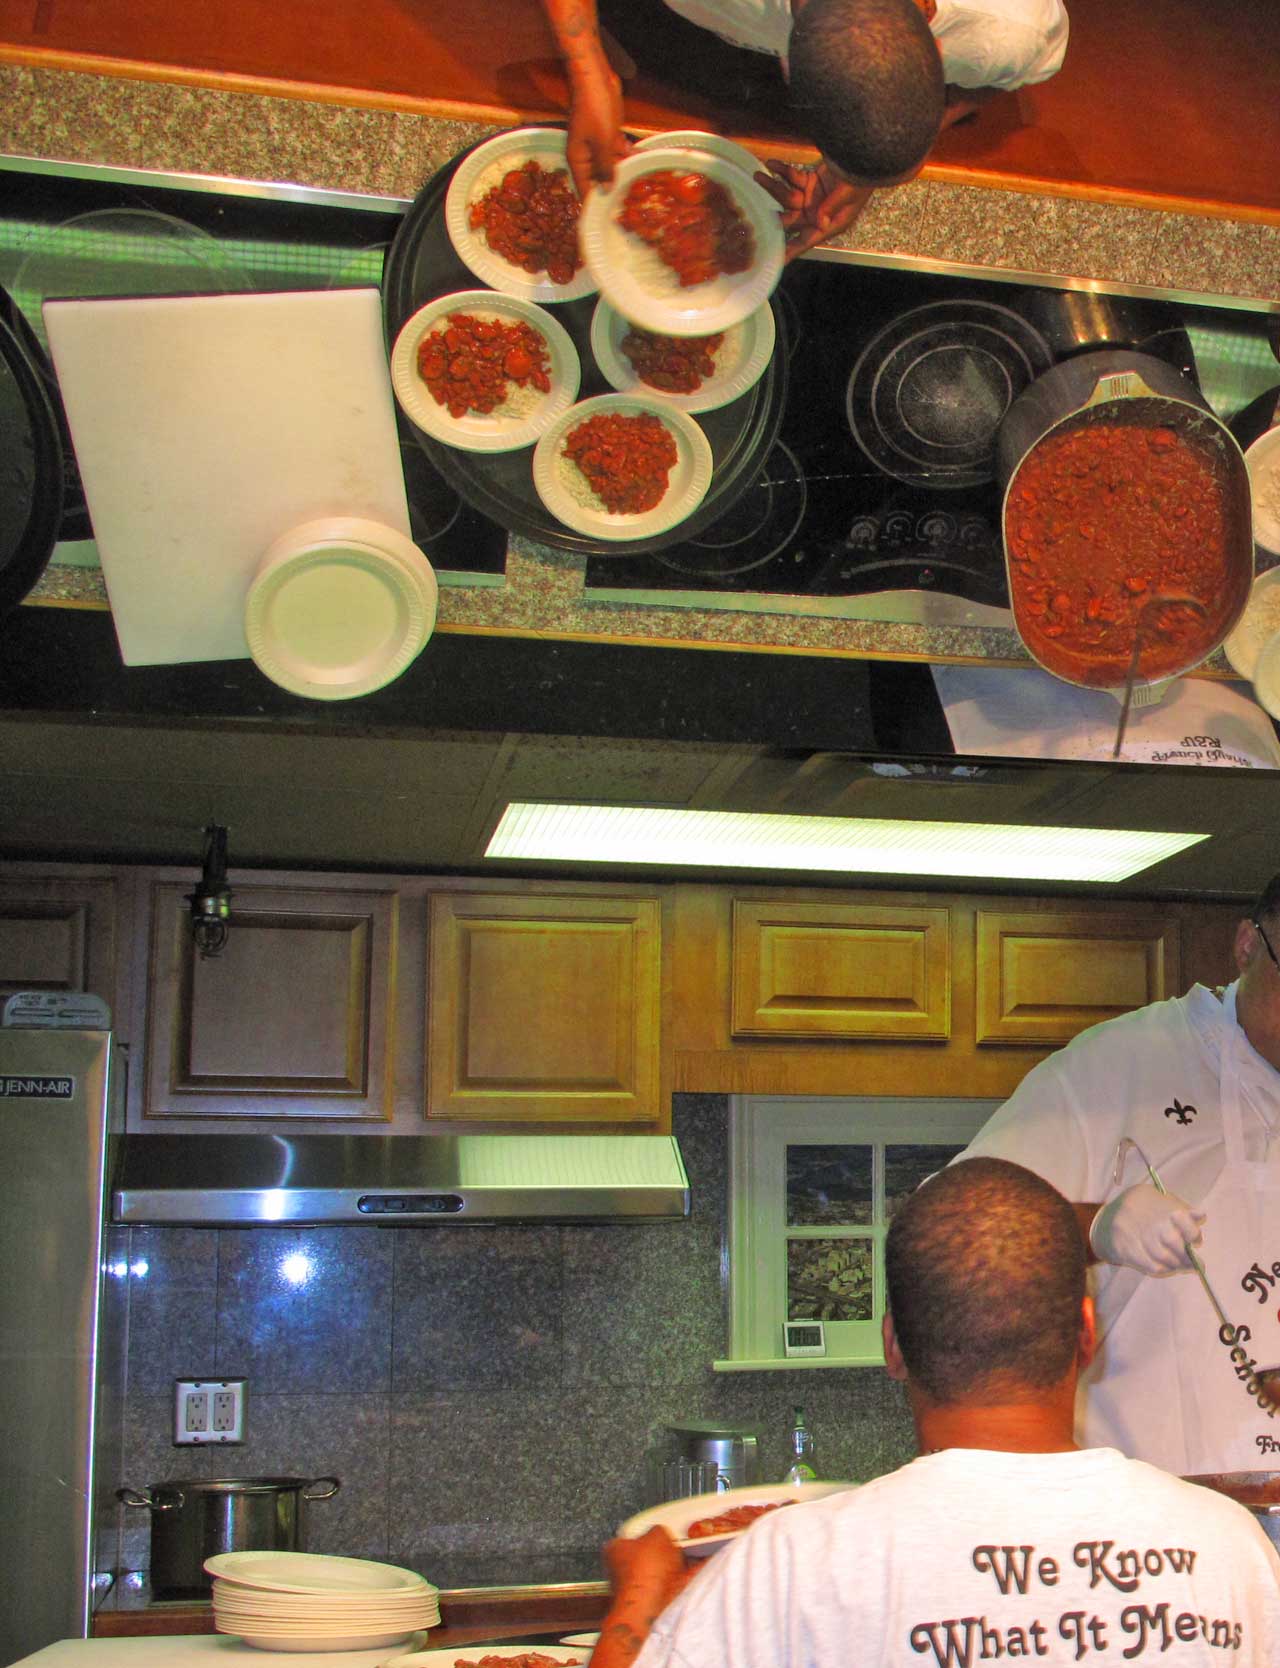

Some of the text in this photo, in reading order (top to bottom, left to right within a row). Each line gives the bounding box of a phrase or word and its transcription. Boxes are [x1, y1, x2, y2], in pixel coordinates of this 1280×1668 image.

[4, 1079, 70, 1096] JENN-AIR
[972, 1540, 1197, 1595] We Know
[910, 1616, 1049, 1668] What
[1059, 1611, 1108, 1661] It
